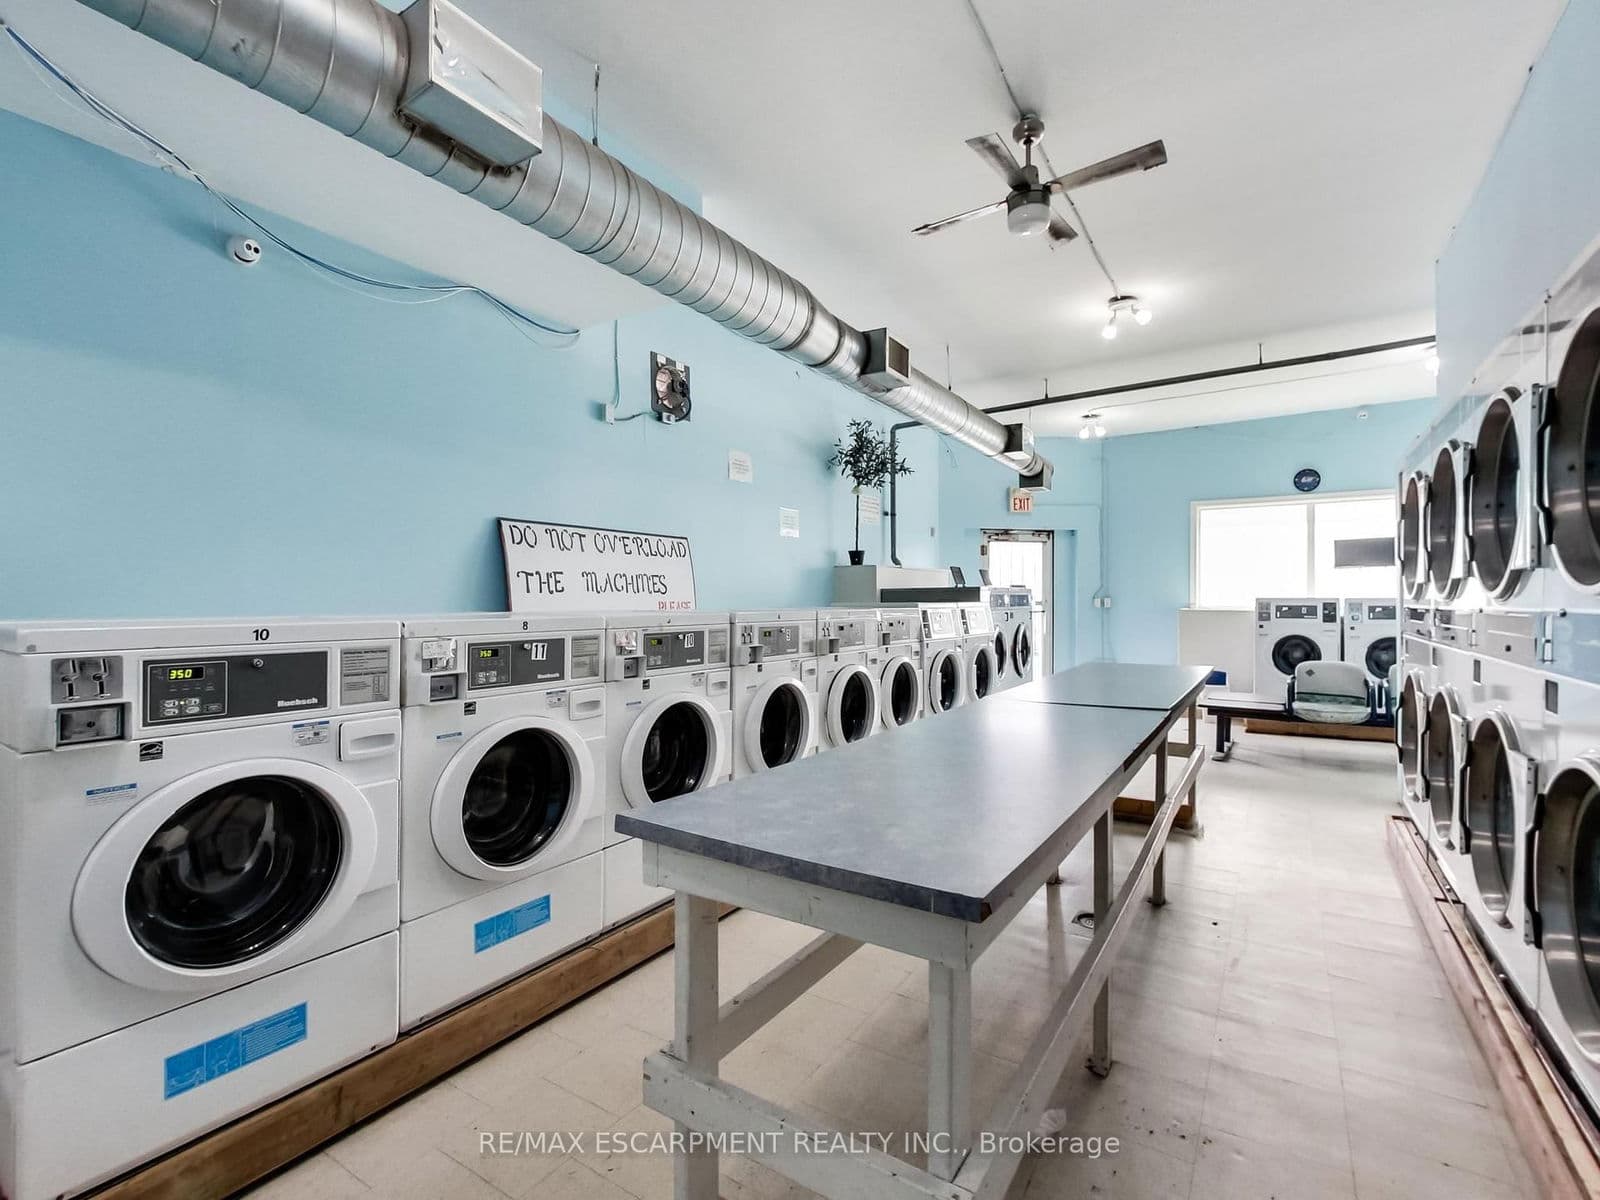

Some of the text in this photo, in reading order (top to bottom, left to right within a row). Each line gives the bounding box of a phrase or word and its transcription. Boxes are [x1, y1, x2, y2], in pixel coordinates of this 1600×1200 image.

[1013, 497, 1031, 511] EXIT
[508, 524, 687, 558] DO NOT OVERLOAD
[516, 571, 668, 595] THE MACHINES
[522, 621, 529, 631] 8
[253, 628, 270, 641] 10
[685, 633, 695, 648] 10
[532, 643, 547, 660] 11
[169, 669, 193, 680] 350
